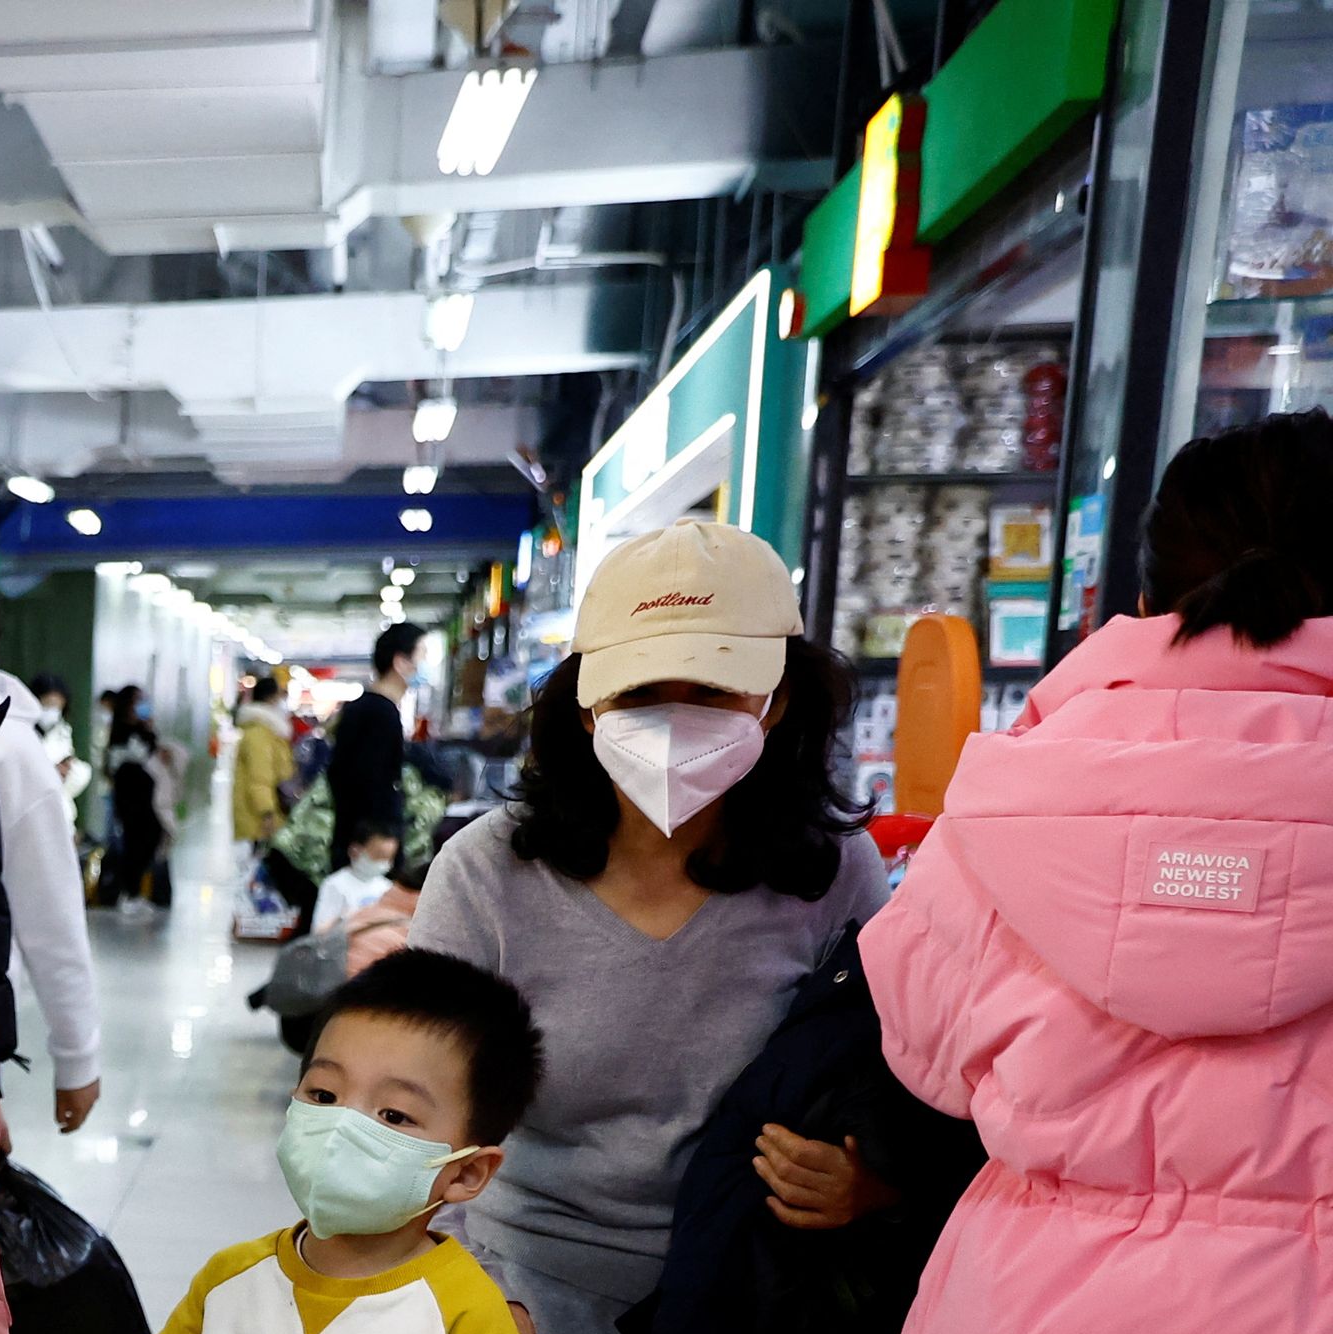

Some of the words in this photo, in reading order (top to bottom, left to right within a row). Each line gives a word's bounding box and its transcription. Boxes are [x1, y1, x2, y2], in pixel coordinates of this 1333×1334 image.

[630, 592, 714, 616] portland
[1157, 851, 1250, 870] ARIAVIGA
[1160, 867, 1242, 885] NEWEST
[1152, 881, 1242, 900] COOLEST
